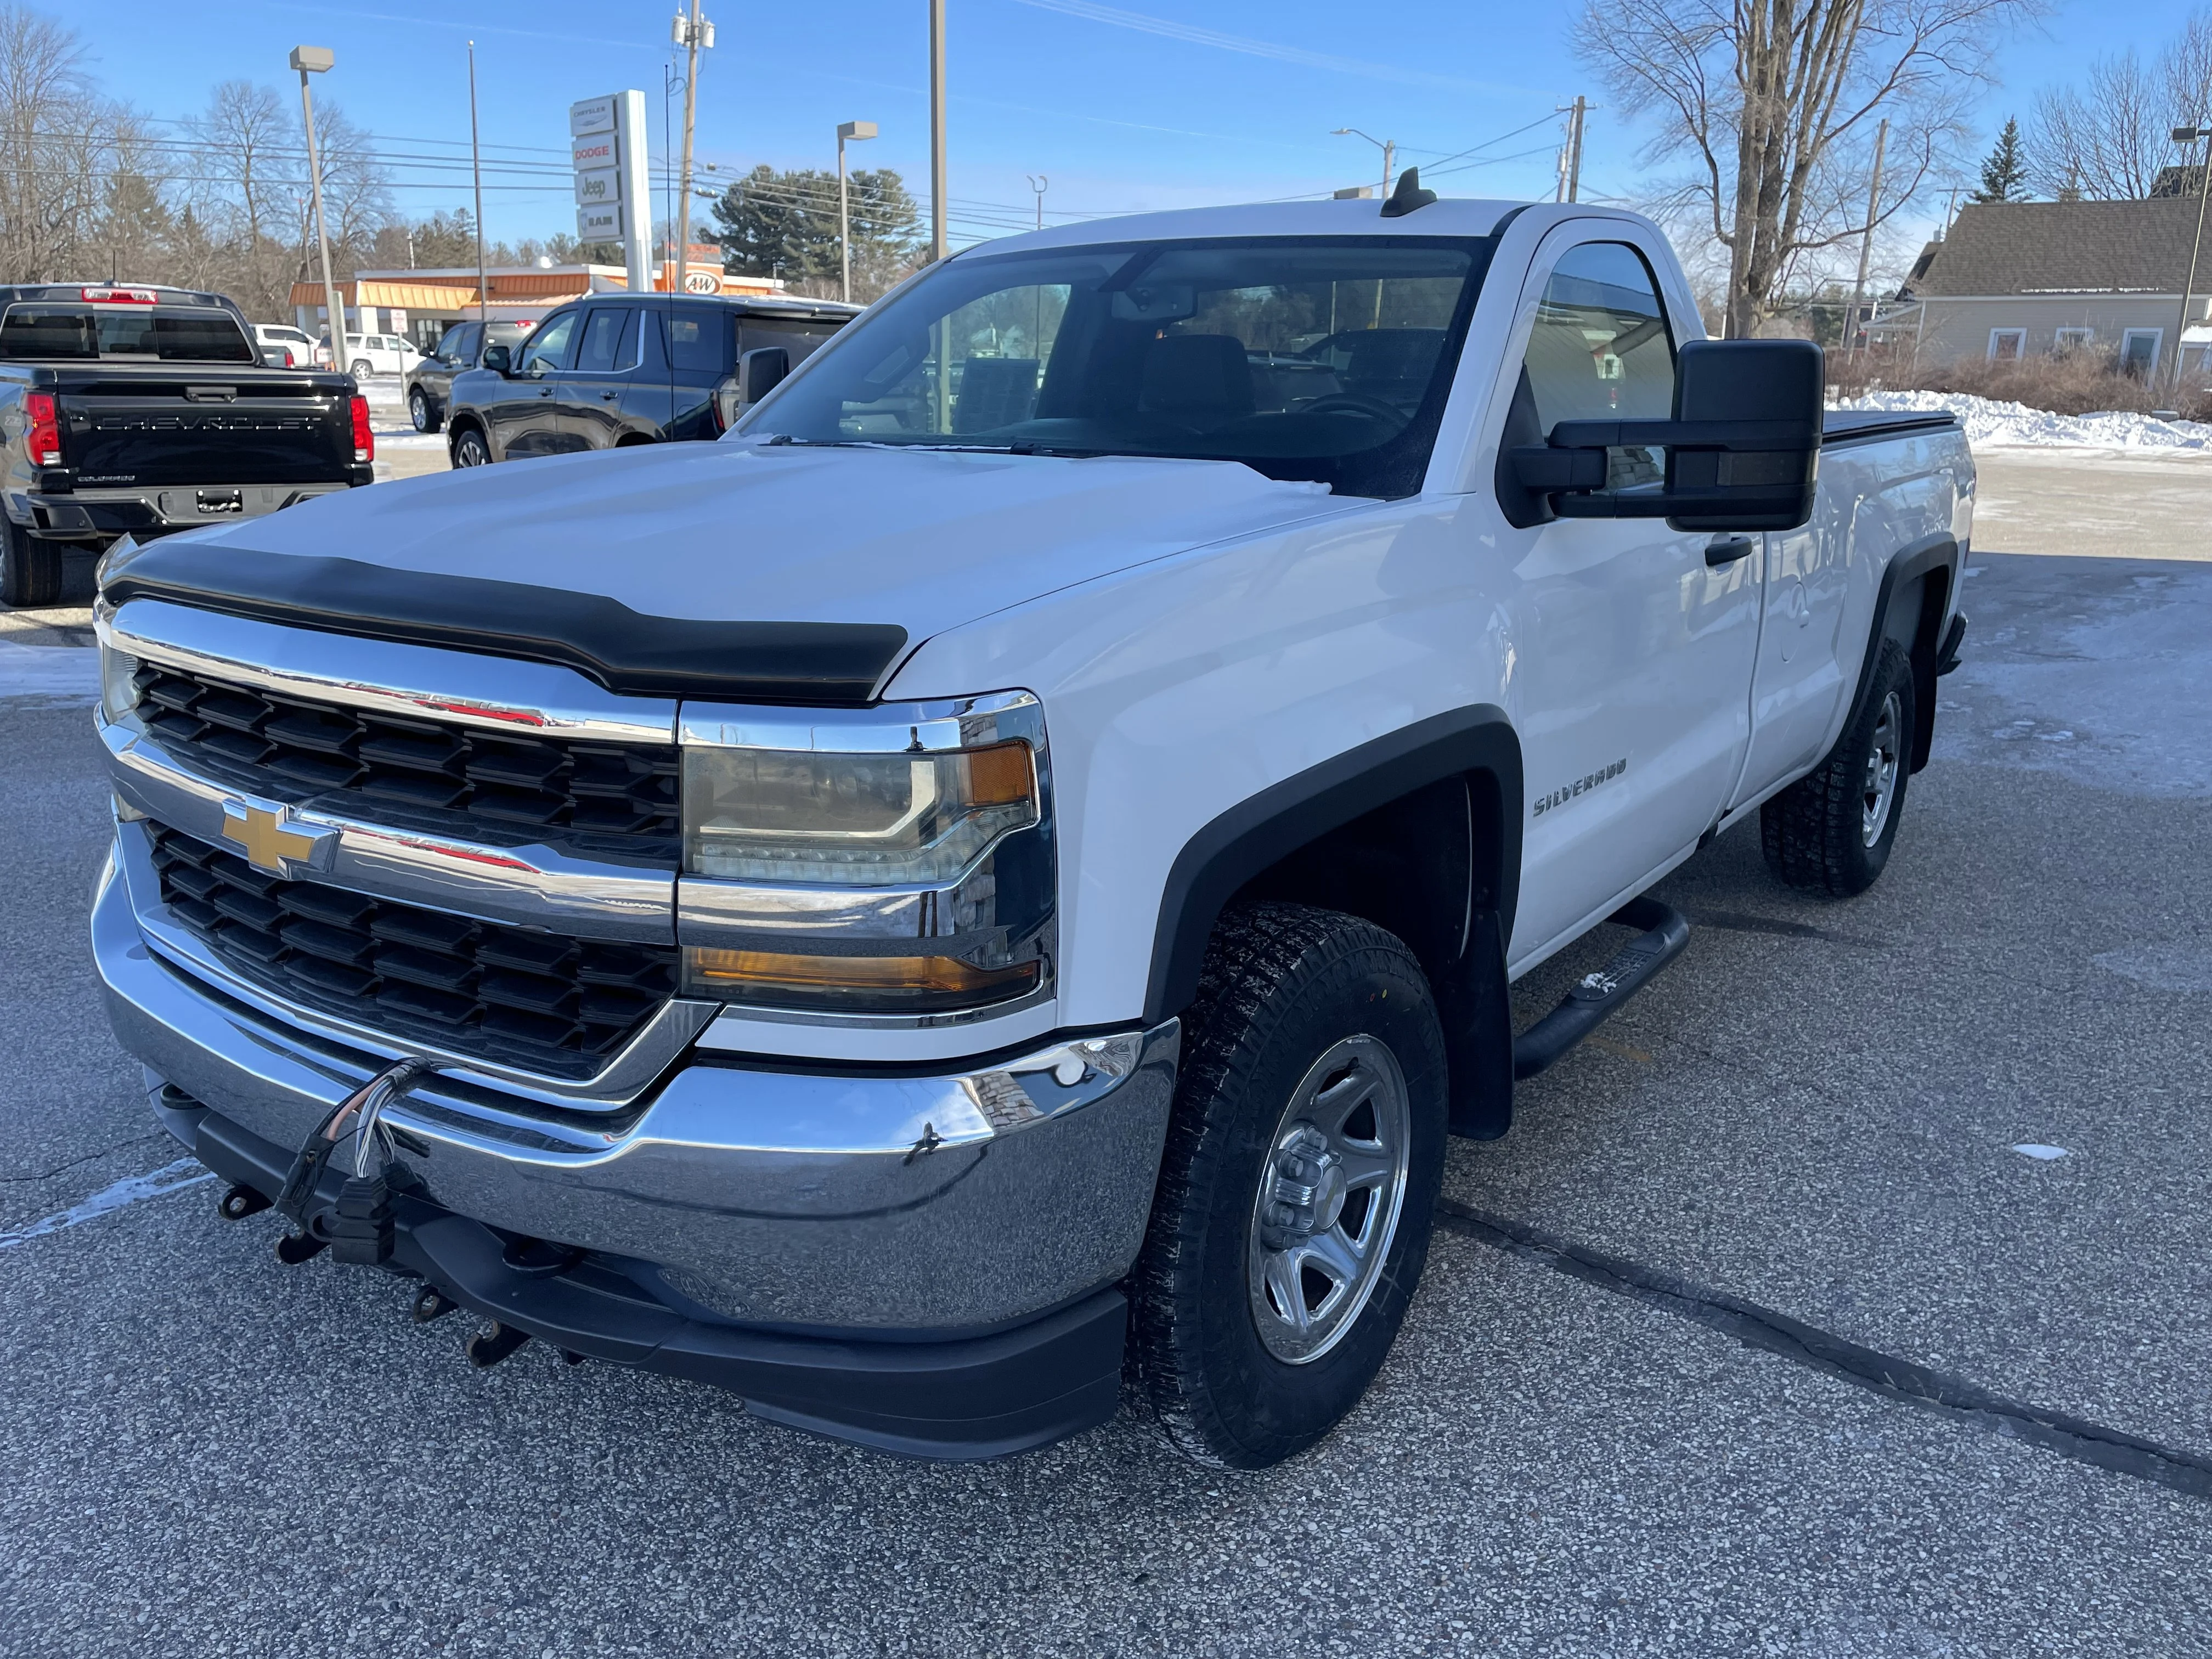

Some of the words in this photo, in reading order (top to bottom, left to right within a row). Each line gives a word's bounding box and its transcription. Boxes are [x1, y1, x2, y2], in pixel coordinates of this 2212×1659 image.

[574, 106, 606, 117] CHRYSLER
[575, 145, 610, 160] DODGE
[582, 177, 606, 199] Jeep
[589, 216, 613, 227] RAM
[95, 417, 322, 431] CHEVROLET
[1533, 757, 1627, 817] SILVERADO
